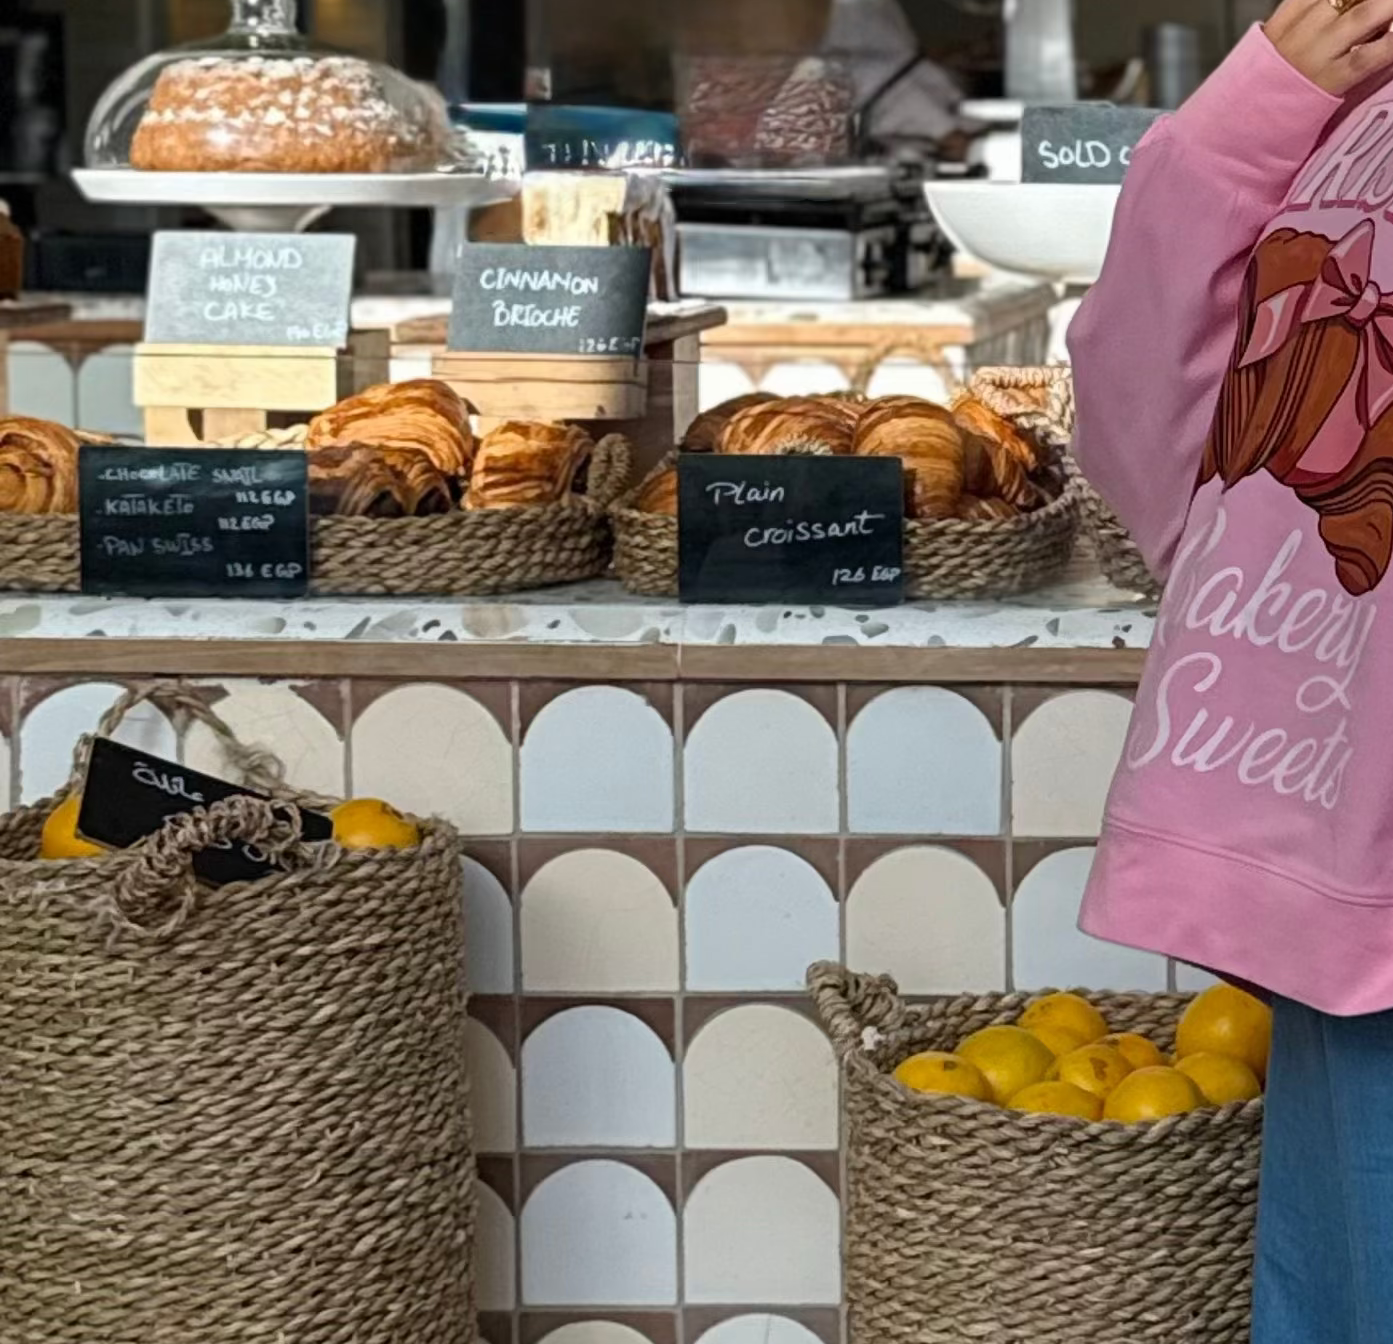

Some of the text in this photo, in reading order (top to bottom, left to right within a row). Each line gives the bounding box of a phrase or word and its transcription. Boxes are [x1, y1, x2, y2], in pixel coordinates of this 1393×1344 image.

[199, 245, 302, 269] ALMOND
[480, 267, 598, 294] CINNAMON
[204, 300, 275, 322] CAKE
[492, 300, 582, 327] BRIOCHE
[103, 533, 214, 556] PAN SWISS
